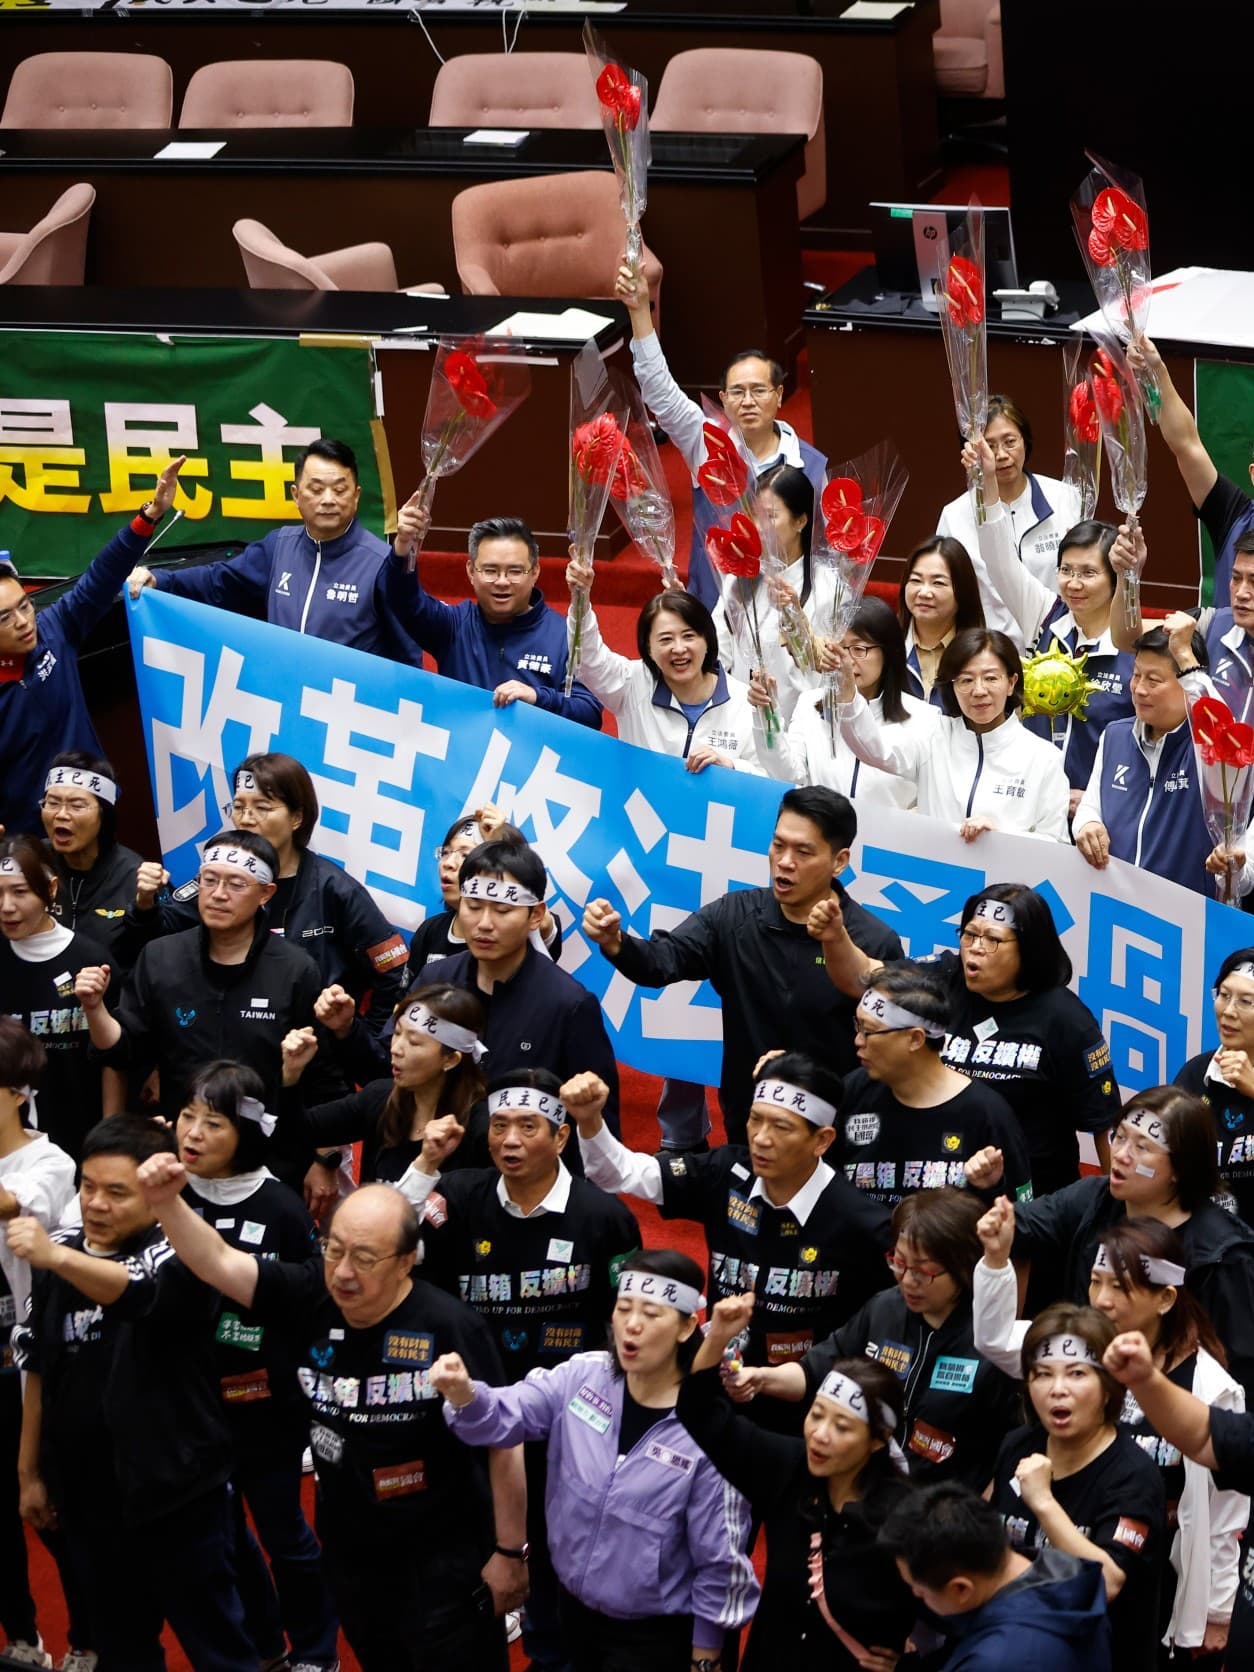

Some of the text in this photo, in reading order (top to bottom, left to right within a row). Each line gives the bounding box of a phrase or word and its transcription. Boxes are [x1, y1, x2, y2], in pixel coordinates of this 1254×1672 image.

[0, 398, 321, 520] 是民主
[326, 588, 359, 604] 魯明哲
[46, 769, 102, 793] 主已死
[202, 847, 257, 874] 主已死
[240, 1009, 276, 1020] TAIWAN
[497, 1090, 563, 1122] 民主已死
[349, 1412, 369, 1423] FOR
